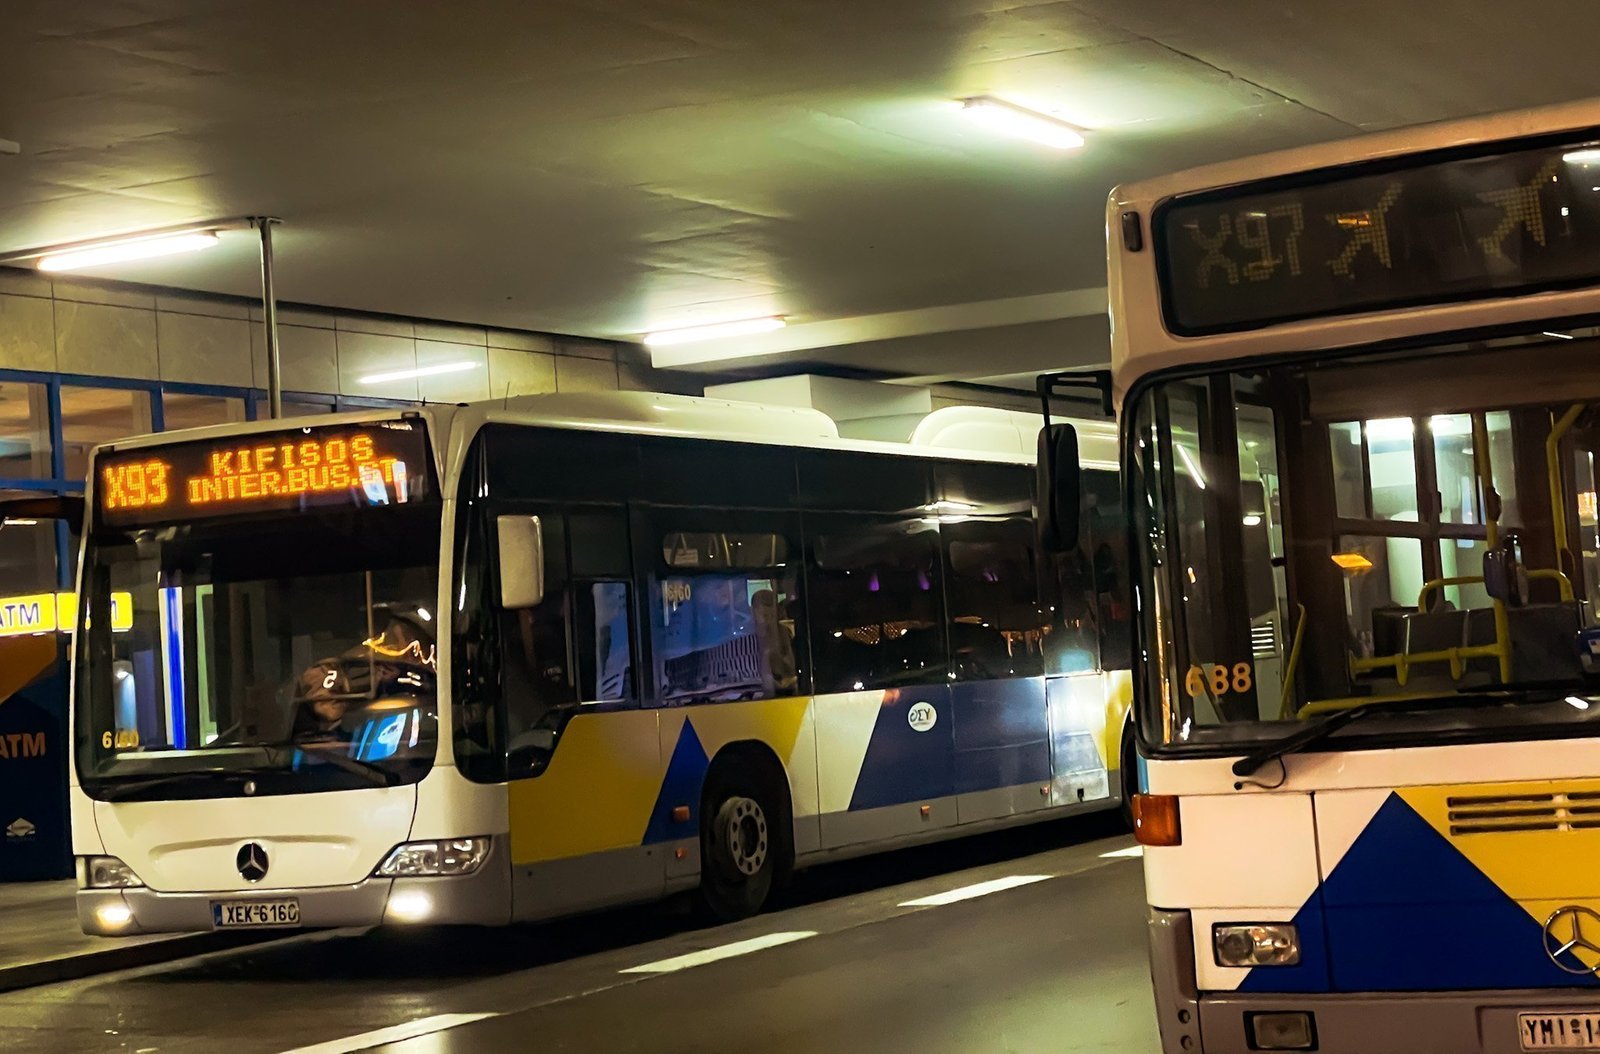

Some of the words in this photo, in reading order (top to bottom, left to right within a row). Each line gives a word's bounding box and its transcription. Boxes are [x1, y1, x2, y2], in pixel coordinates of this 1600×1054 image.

[1190, 203, 1304, 288] X97
[212, 435, 375, 477] KIFISOS
[104, 460, 169, 509] X93
[1185, 662, 1252, 698] 688
[1525, 1018, 1600, 1045] YMI-1
